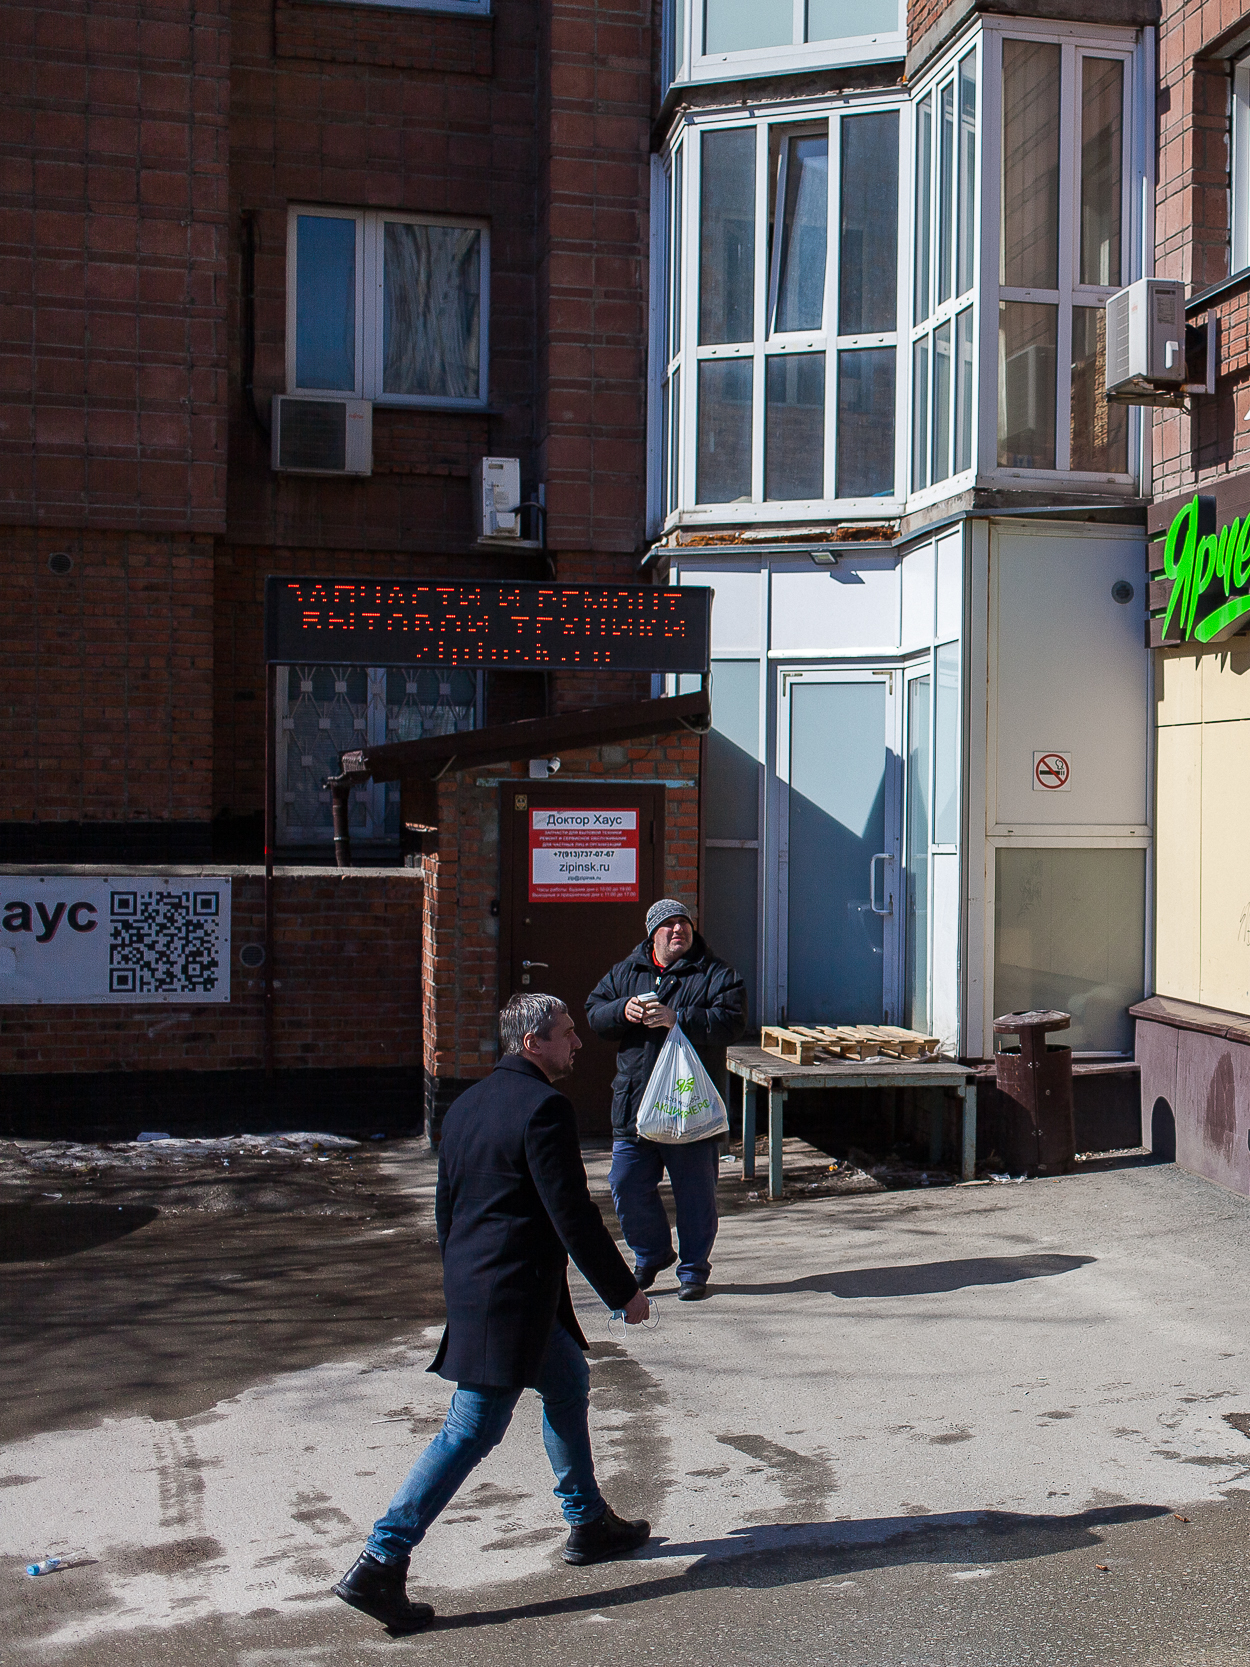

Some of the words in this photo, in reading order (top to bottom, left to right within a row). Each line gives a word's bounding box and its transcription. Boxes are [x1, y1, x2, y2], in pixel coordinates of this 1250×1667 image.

[546, 814, 590, 827] Доктор
[593, 814, 623, 827] Хаус
[559, 862, 610, 874] zipinsk.ru
[0, 901, 98, 943] аус
